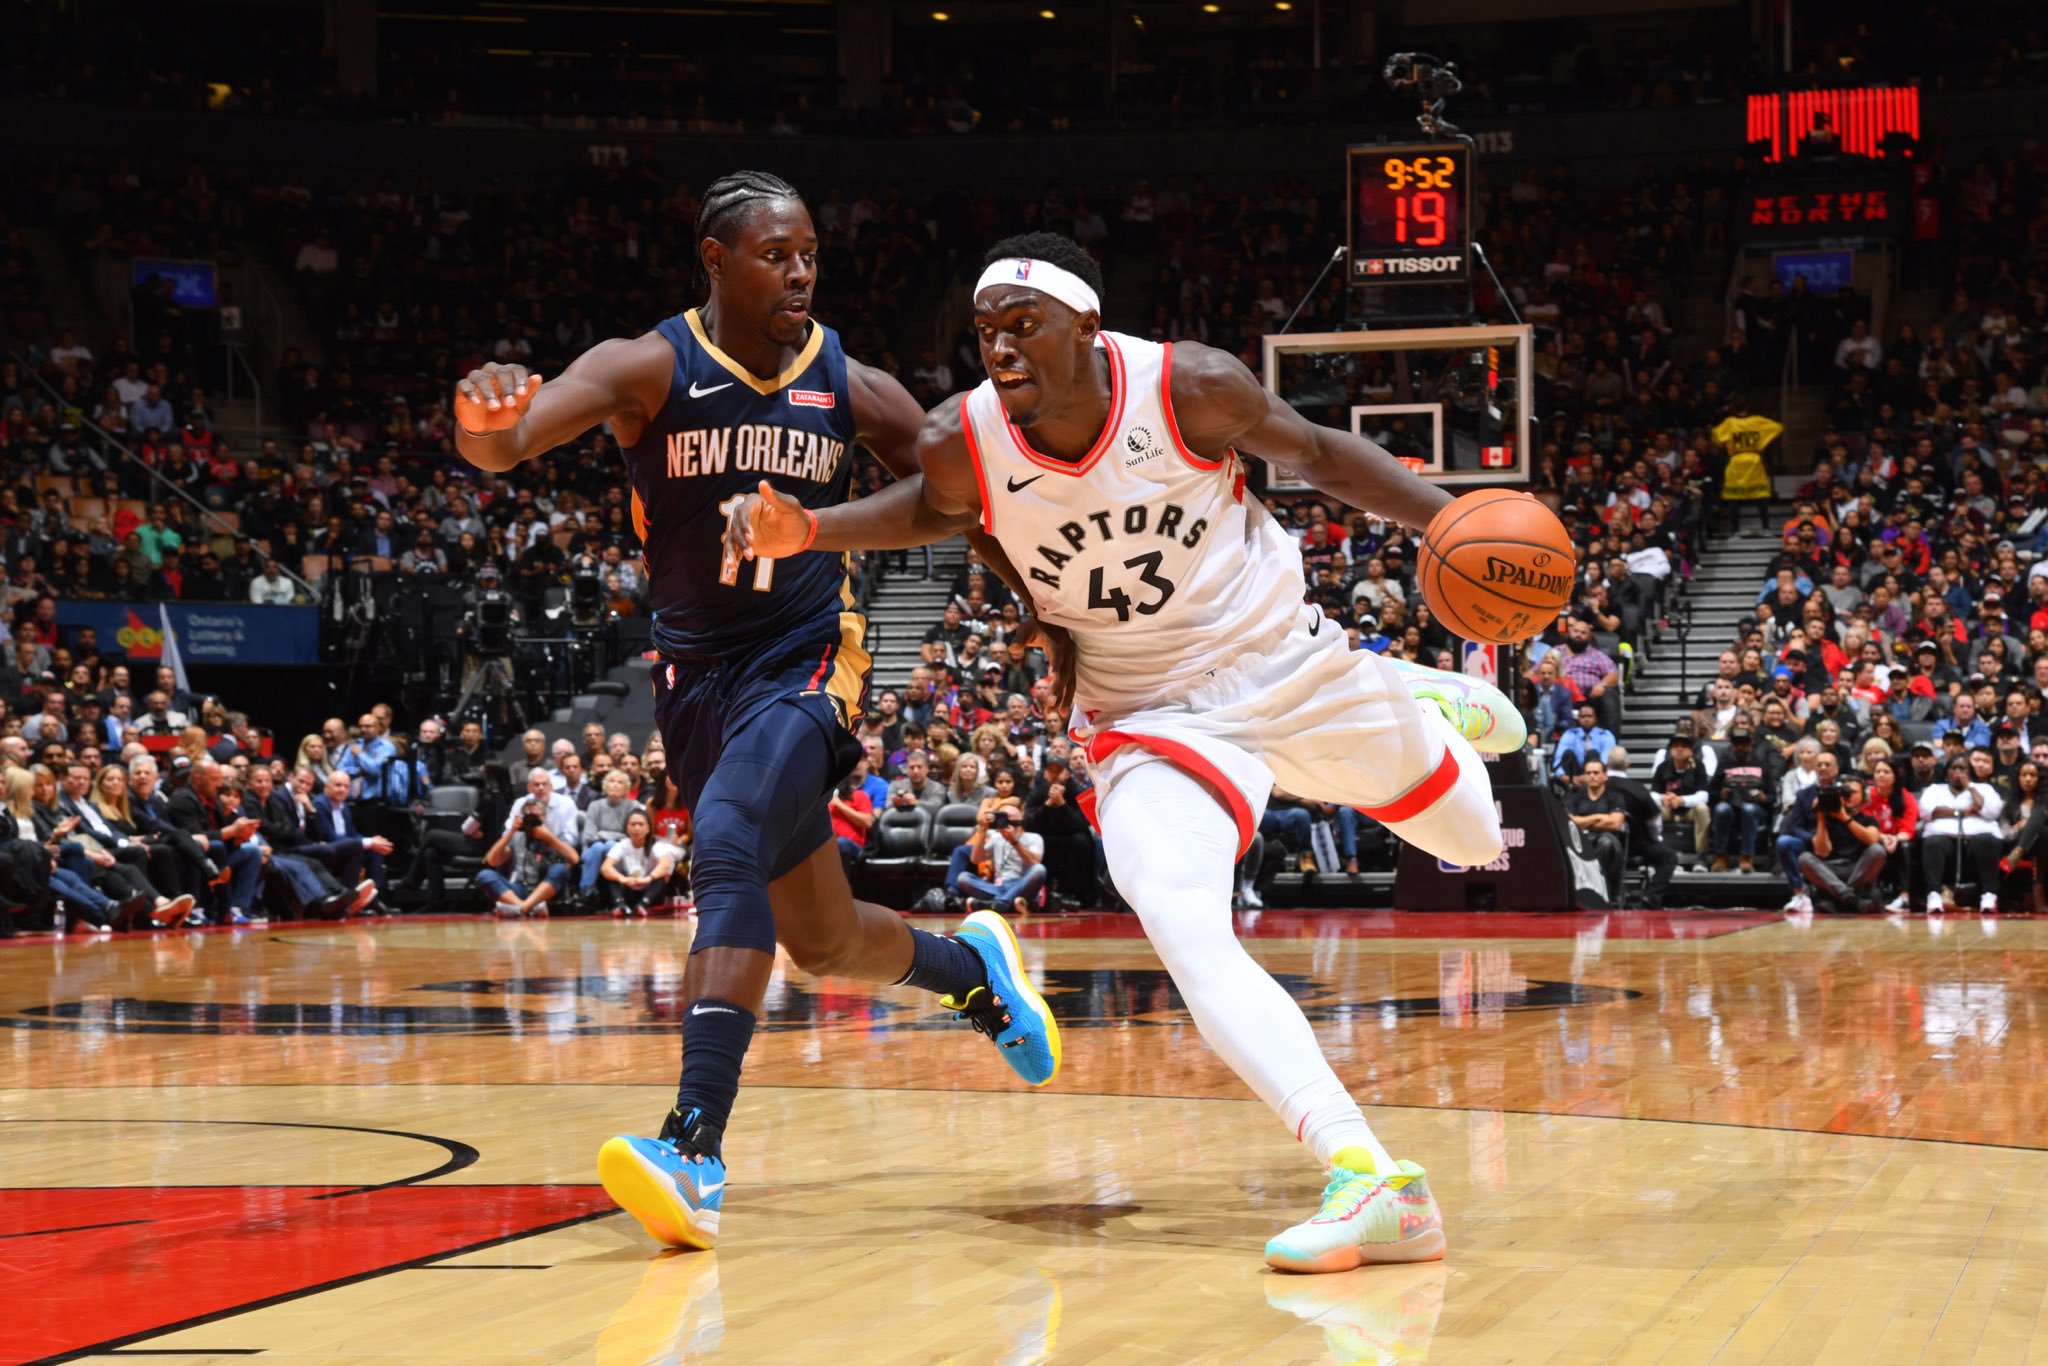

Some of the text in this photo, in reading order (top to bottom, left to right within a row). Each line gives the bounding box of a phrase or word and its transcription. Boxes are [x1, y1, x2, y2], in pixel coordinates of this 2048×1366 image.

[1384, 156, 1455, 190] 9:52
[1395, 191, 1446, 246] 19
[1752, 205, 1888, 224] NORTH
[1754, 191, 1887, 209] WE THE
[1384, 256, 1462, 273] TISSOT
[667, 424, 844, 484] NEW ORLEANS
[1125, 447, 1164, 469] Sun Life
[1029, 503, 1208, 591] RAPTORS
[1087, 550, 1175, 622] 43
[1482, 556, 1572, 600] SPALDING
